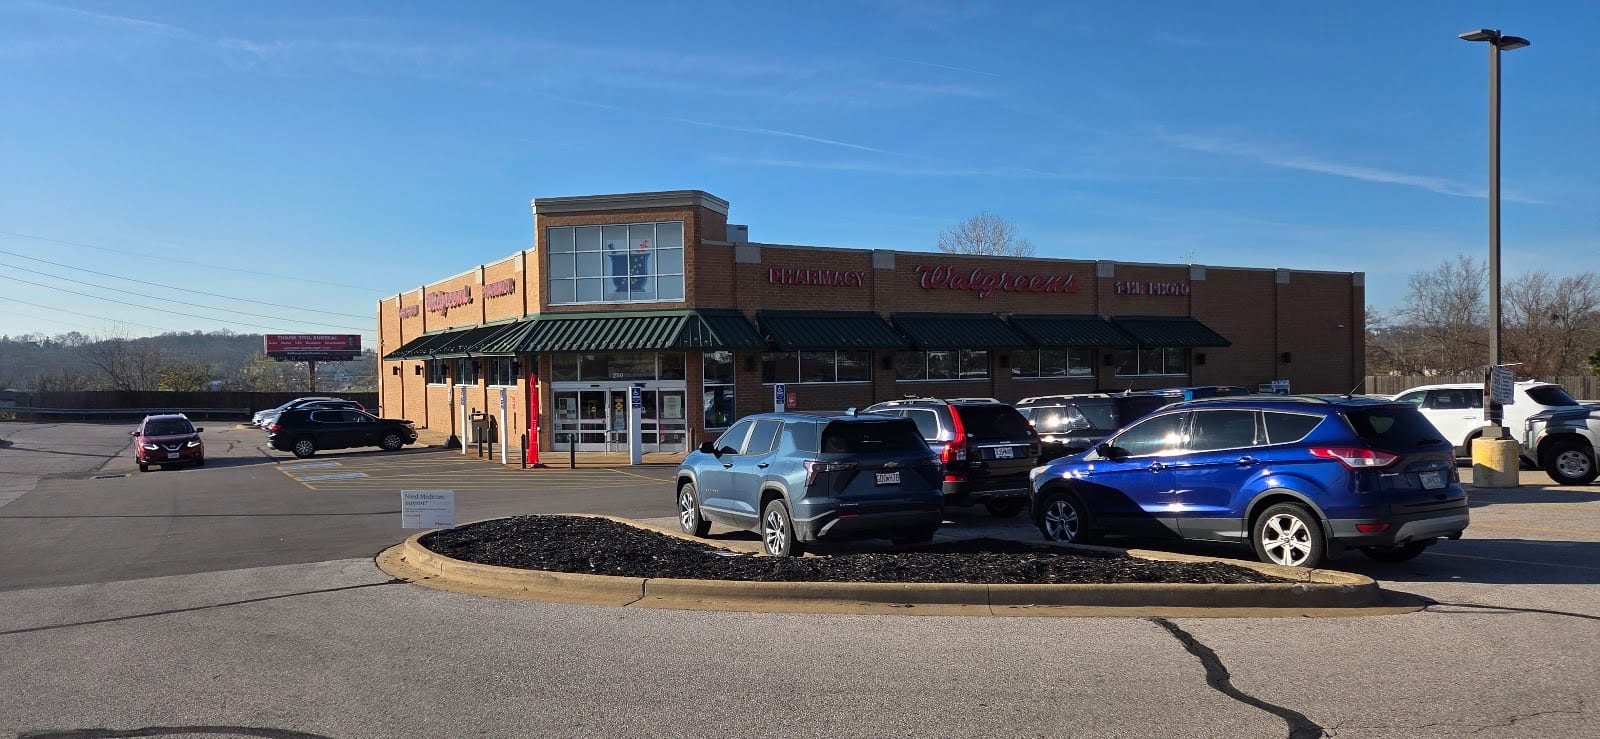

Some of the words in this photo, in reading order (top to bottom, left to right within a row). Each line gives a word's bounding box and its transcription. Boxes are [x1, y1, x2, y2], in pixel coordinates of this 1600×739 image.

[768, 267, 866, 288] PHARMACY
[915, 265, 1079, 299] Walgreens
[1148, 281, 1190, 296] PHOTO
